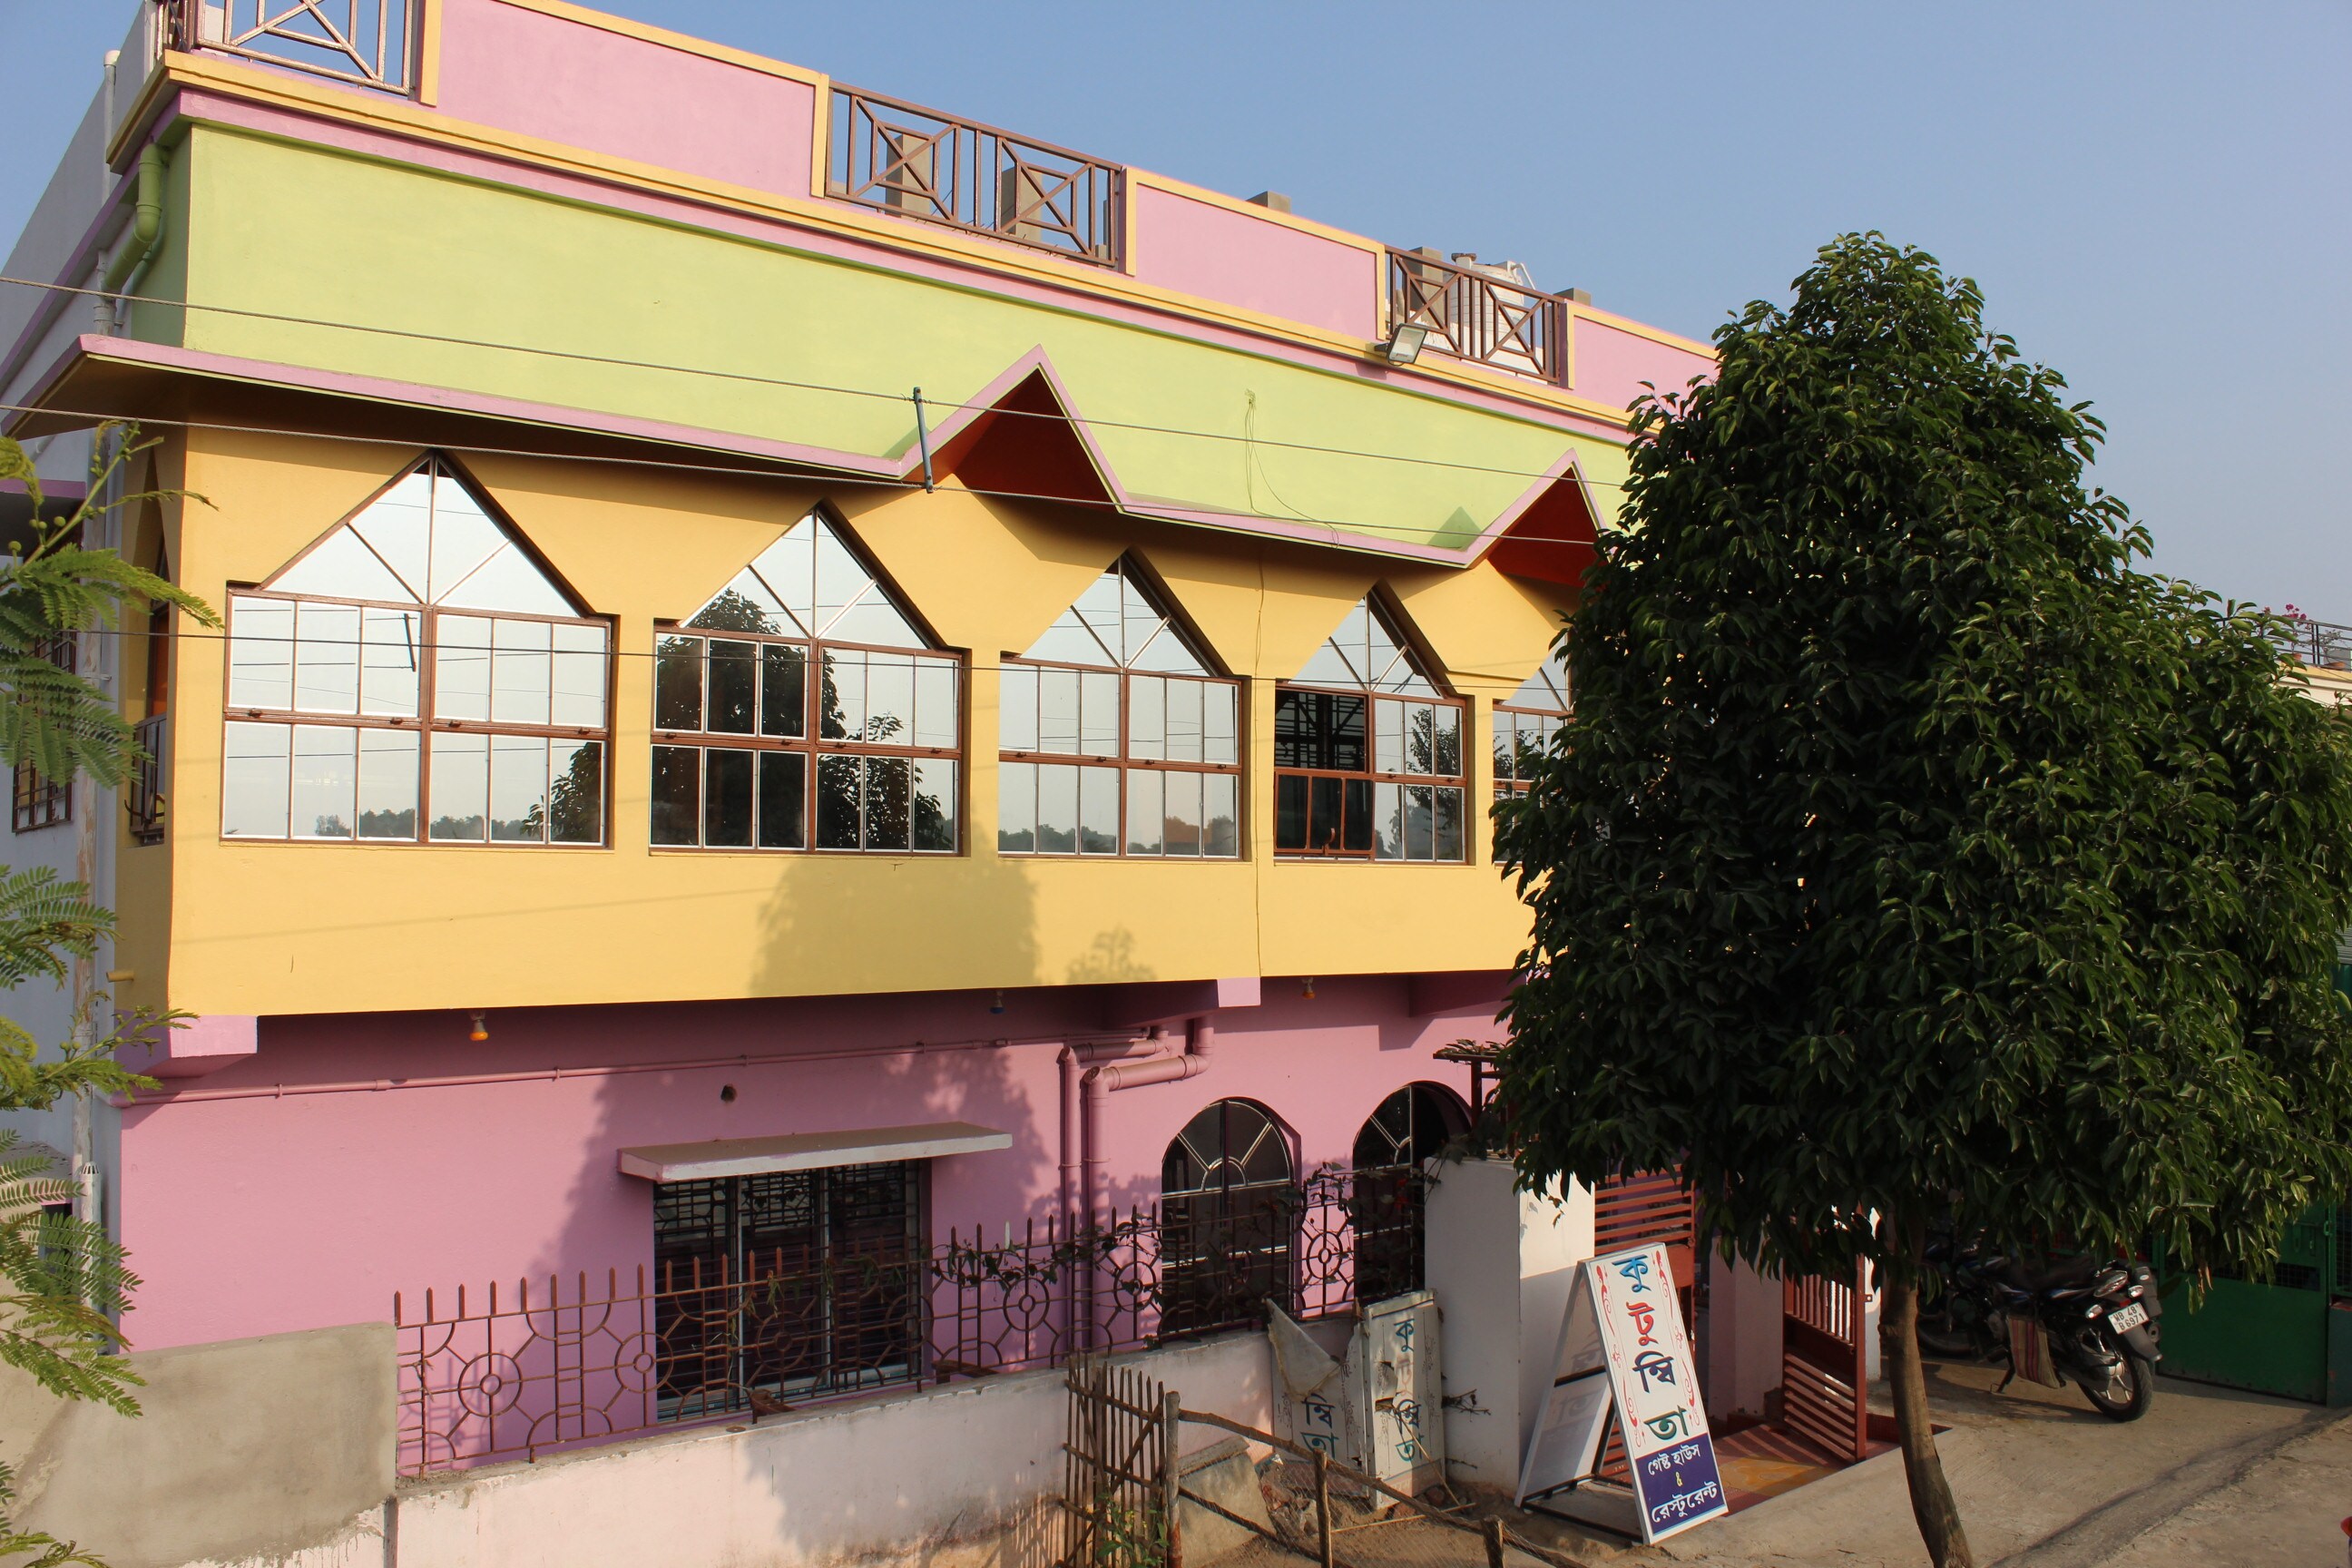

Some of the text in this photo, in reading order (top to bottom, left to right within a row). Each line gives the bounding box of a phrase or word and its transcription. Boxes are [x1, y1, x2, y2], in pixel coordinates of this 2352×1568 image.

[2112, 1306, 2137, 1322] WB 48
[2118, 1312, 2145, 1330] B 6971
[1671, 1444, 1701, 1466] হাউস
[1675, 1471, 1683, 1487] &
[1651, 1481, 1718, 1523] রেস্টুরেন্ট
